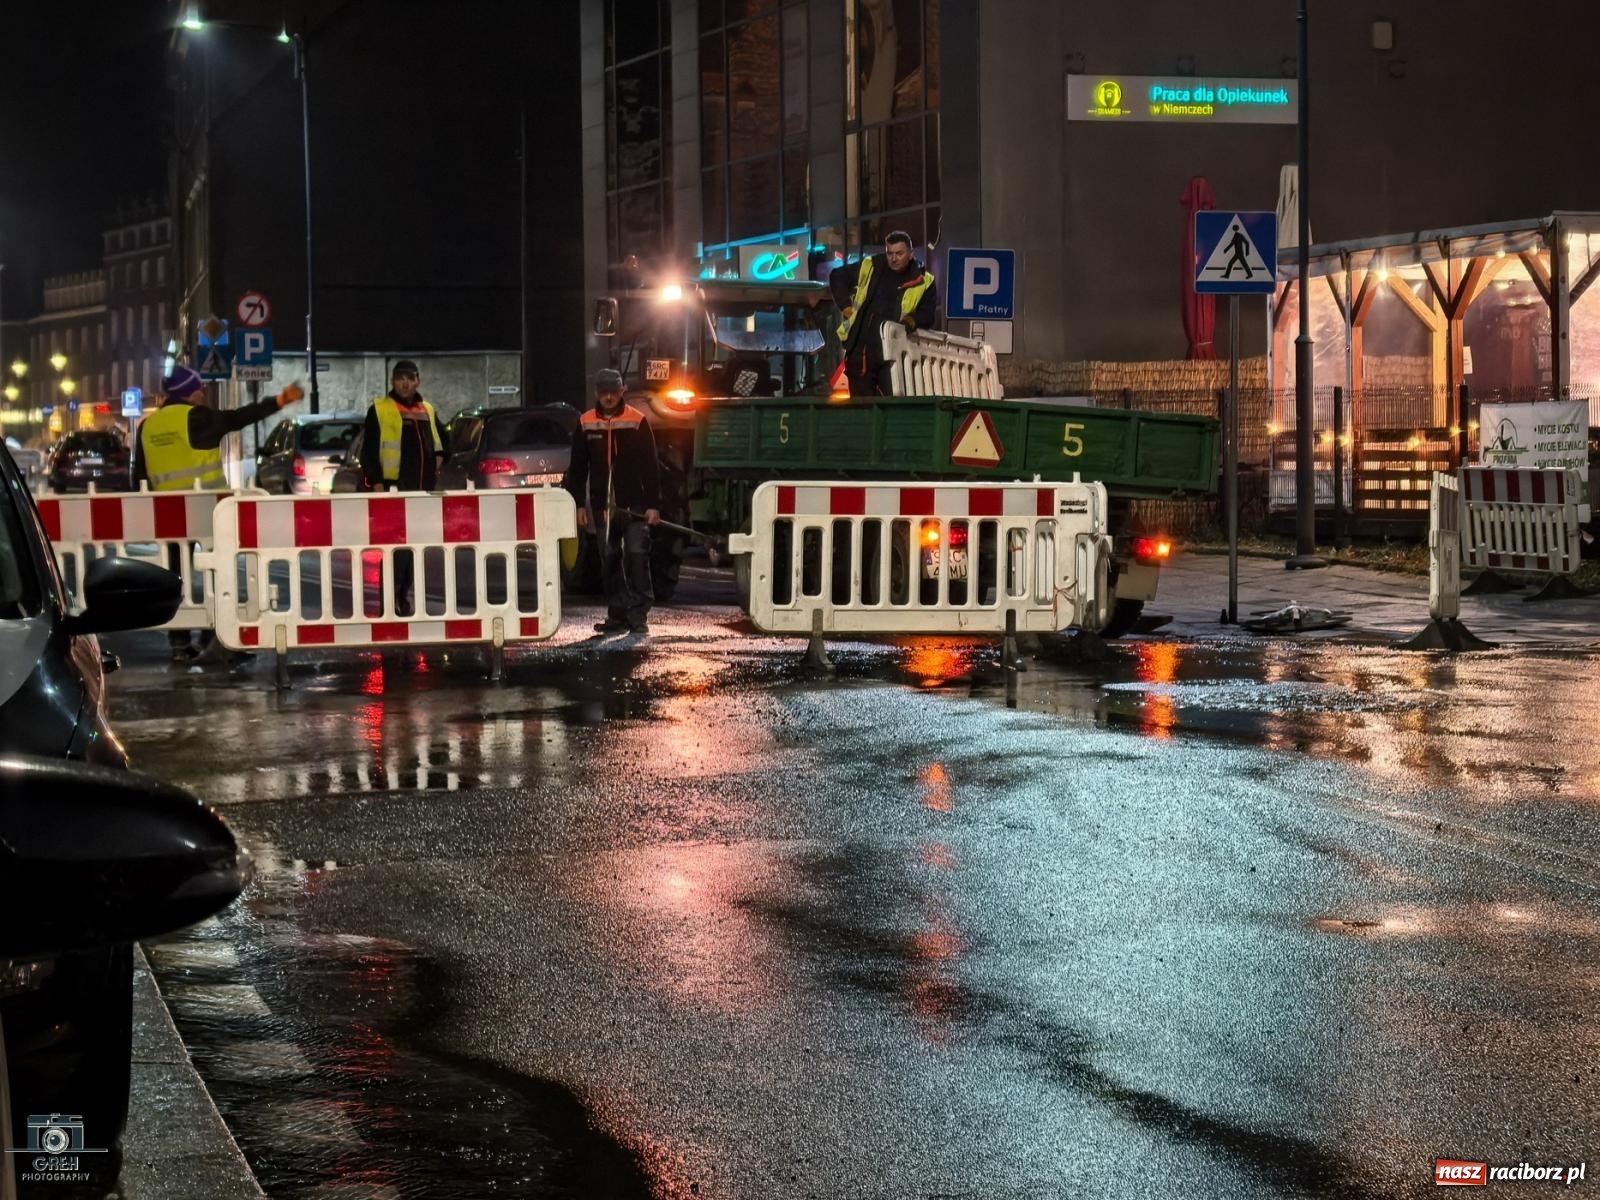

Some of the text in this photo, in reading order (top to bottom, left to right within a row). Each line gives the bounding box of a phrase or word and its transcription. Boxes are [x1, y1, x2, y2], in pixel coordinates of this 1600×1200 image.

[1152, 86, 1289, 105] Praca dla Opiekunek
[1152, 103, 1214, 115] w Niemczech
[962, 257, 1000, 310] P
[978, 304, 1009, 315] Płatny
[244, 332, 265, 361] P
[125, 393, 135, 406] P
[779, 412, 790, 444] 5
[1062, 422, 1085, 457] 5
